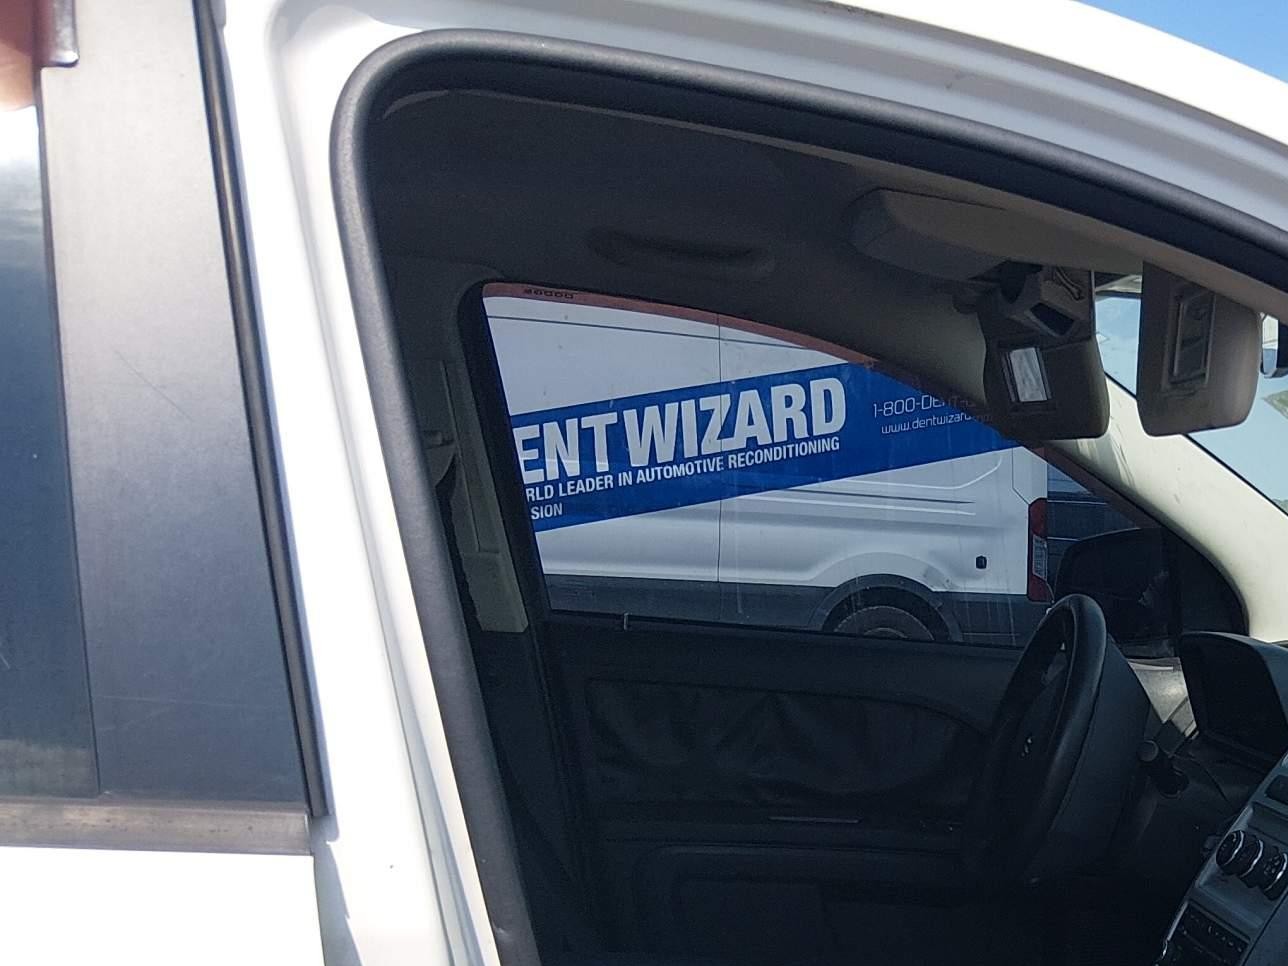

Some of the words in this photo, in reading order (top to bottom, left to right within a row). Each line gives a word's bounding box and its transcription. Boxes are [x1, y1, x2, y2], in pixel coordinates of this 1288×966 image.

[622, 377, 846, 467] WIZARD
[558, 474, 614, 497] LEADER
[618, 470, 633, 487] IN
[636, 456, 724, 484] AUTOMOTIVE
[728, 436, 840, 469] RECONDITIONING
[530, 502, 563, 520] SION
